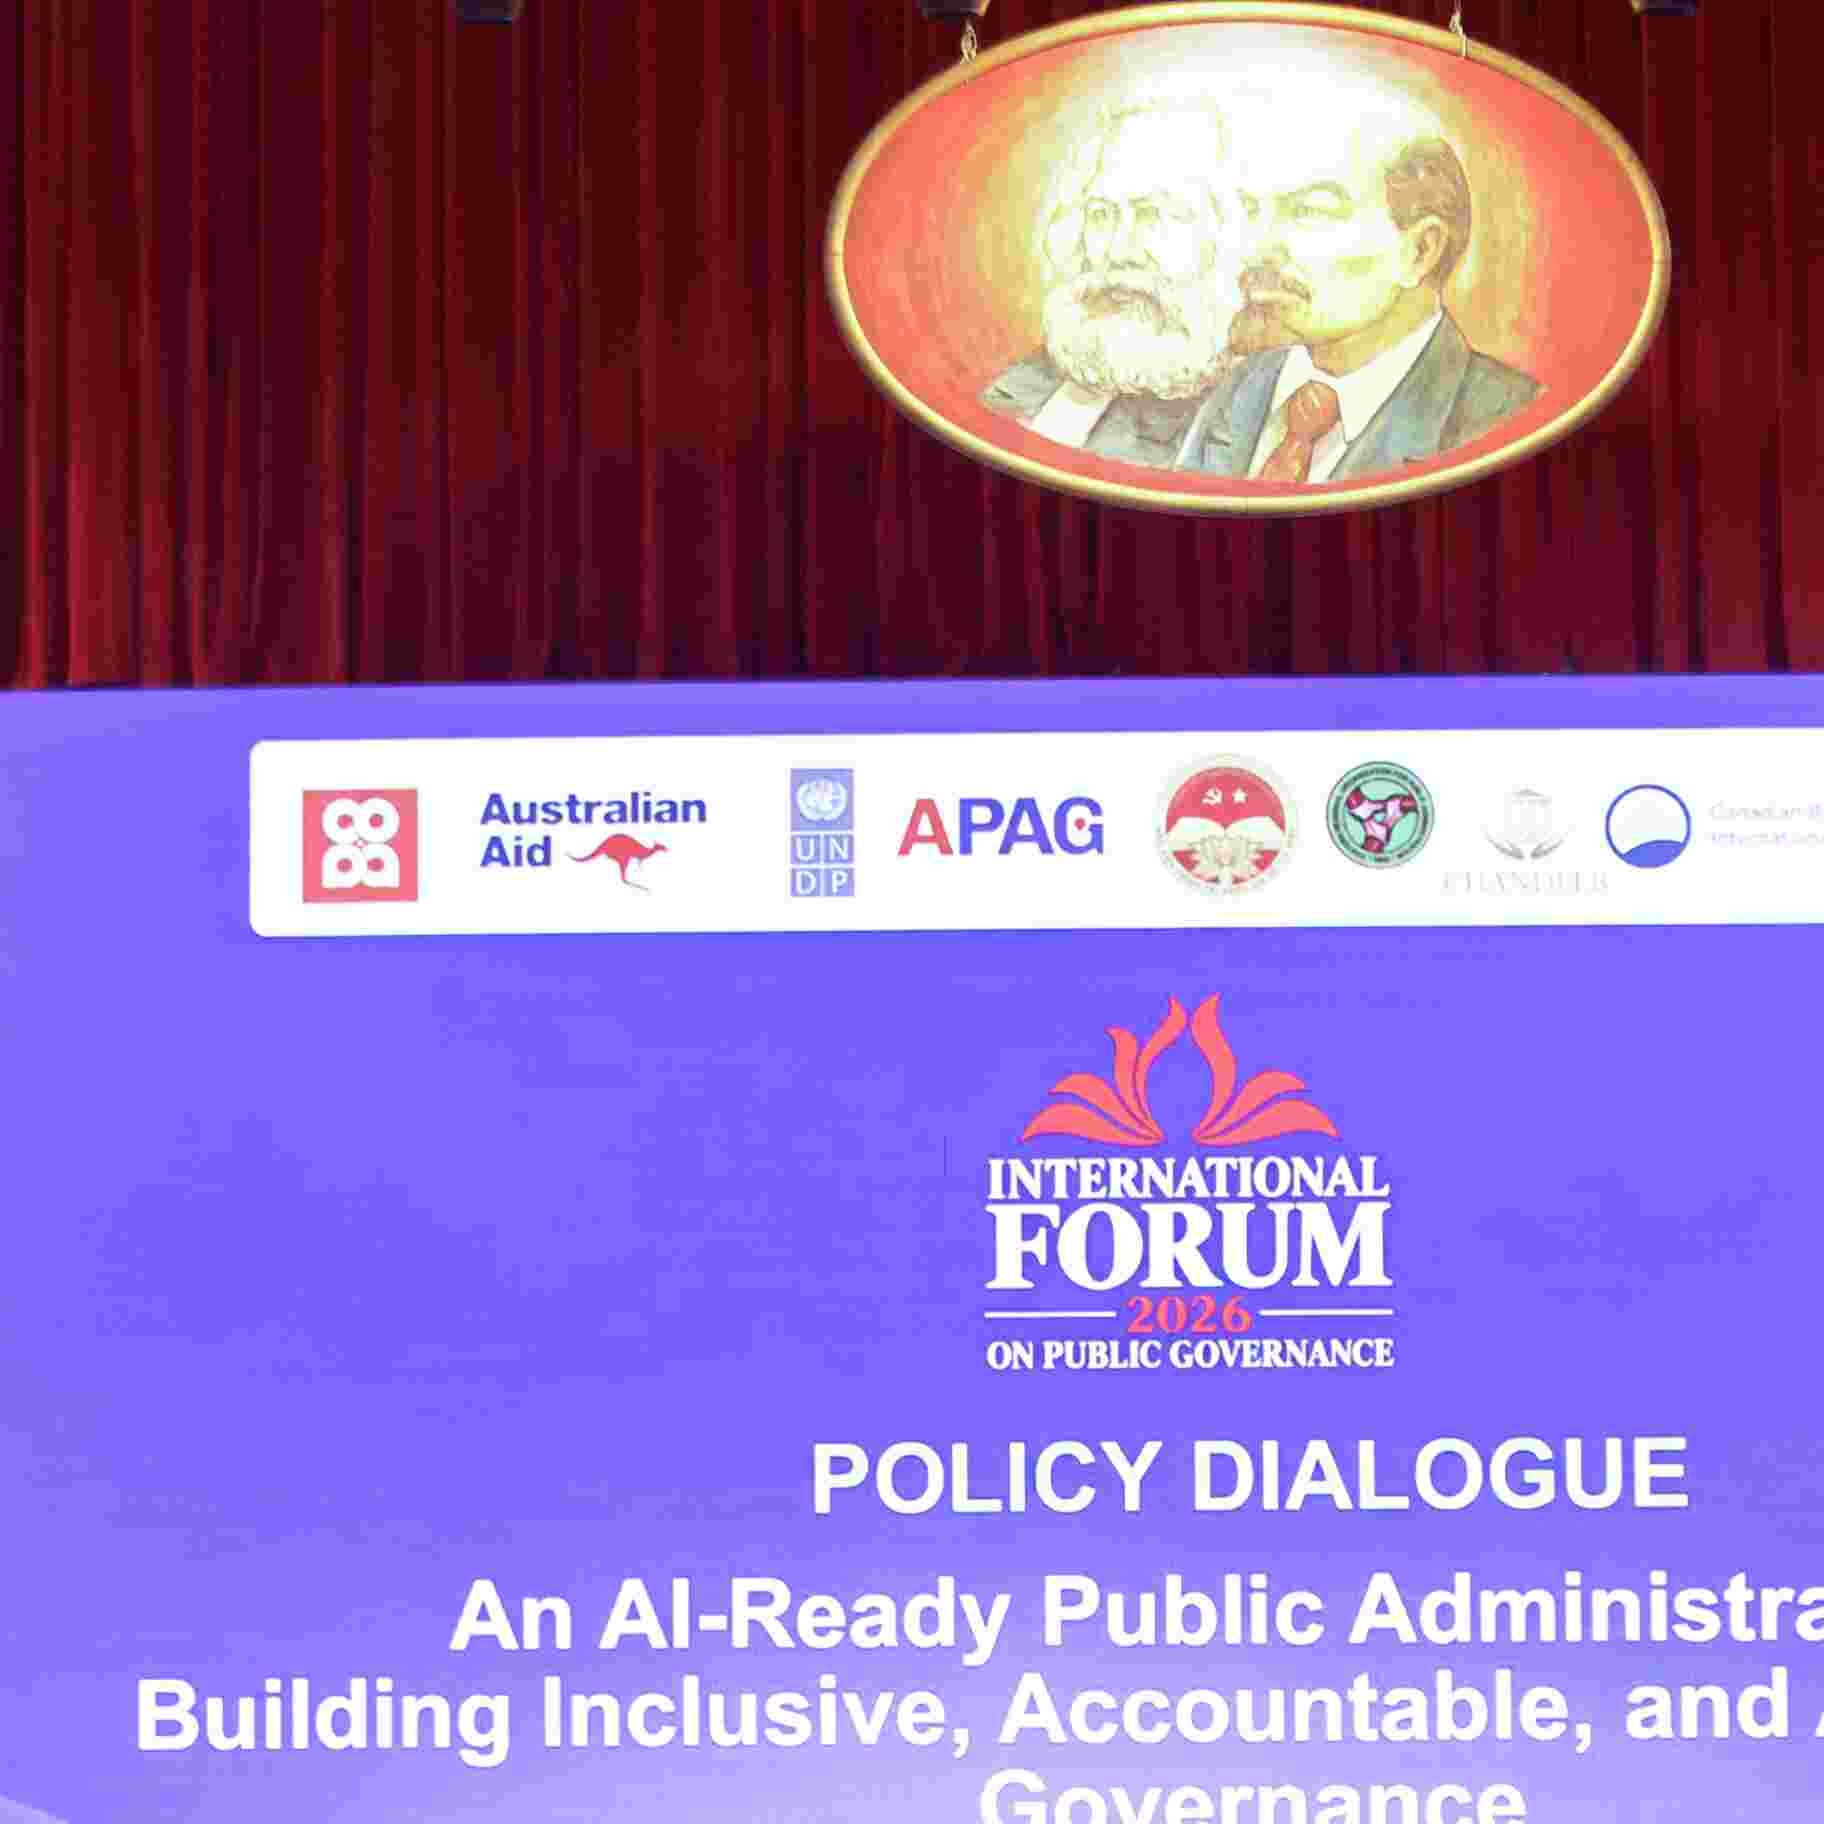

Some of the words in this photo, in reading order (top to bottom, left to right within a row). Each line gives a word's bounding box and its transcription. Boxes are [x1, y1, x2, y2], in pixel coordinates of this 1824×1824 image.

[480, 791, 707, 825] Australian
[898, 796, 1104, 857] APAG
[480, 835, 552, 868] Aid
[795, 836, 849, 862] UN
[795, 869, 849, 895] DP
[988, 1155, 1390, 1200] INTERNATIONAL
[985, 1201, 1393, 1291] FORUM
[1126, 1295, 1254, 1334] 2026
[987, 1341, 1034, 1370] ON
[1043, 1340, 1162, 1369] PUBLIC
[1169, 1338, 1394, 1369] GOVERNANCE
[814, 1440, 1163, 1514] POLICY
[1194, 1437, 1689, 1511] DIALOGUE
[449, 1579, 572, 1650] An
[599, 1575, 1011, 1663] AI-Ready
[1044, 1573, 1325, 1647] Public
[138, 1677, 509, 1766] Building
[544, 1674, 969, 1757] Inclusive,
[997, 1669, 1591, 1754] Accountable,
[1626, 1666, 1788, 1739] and
